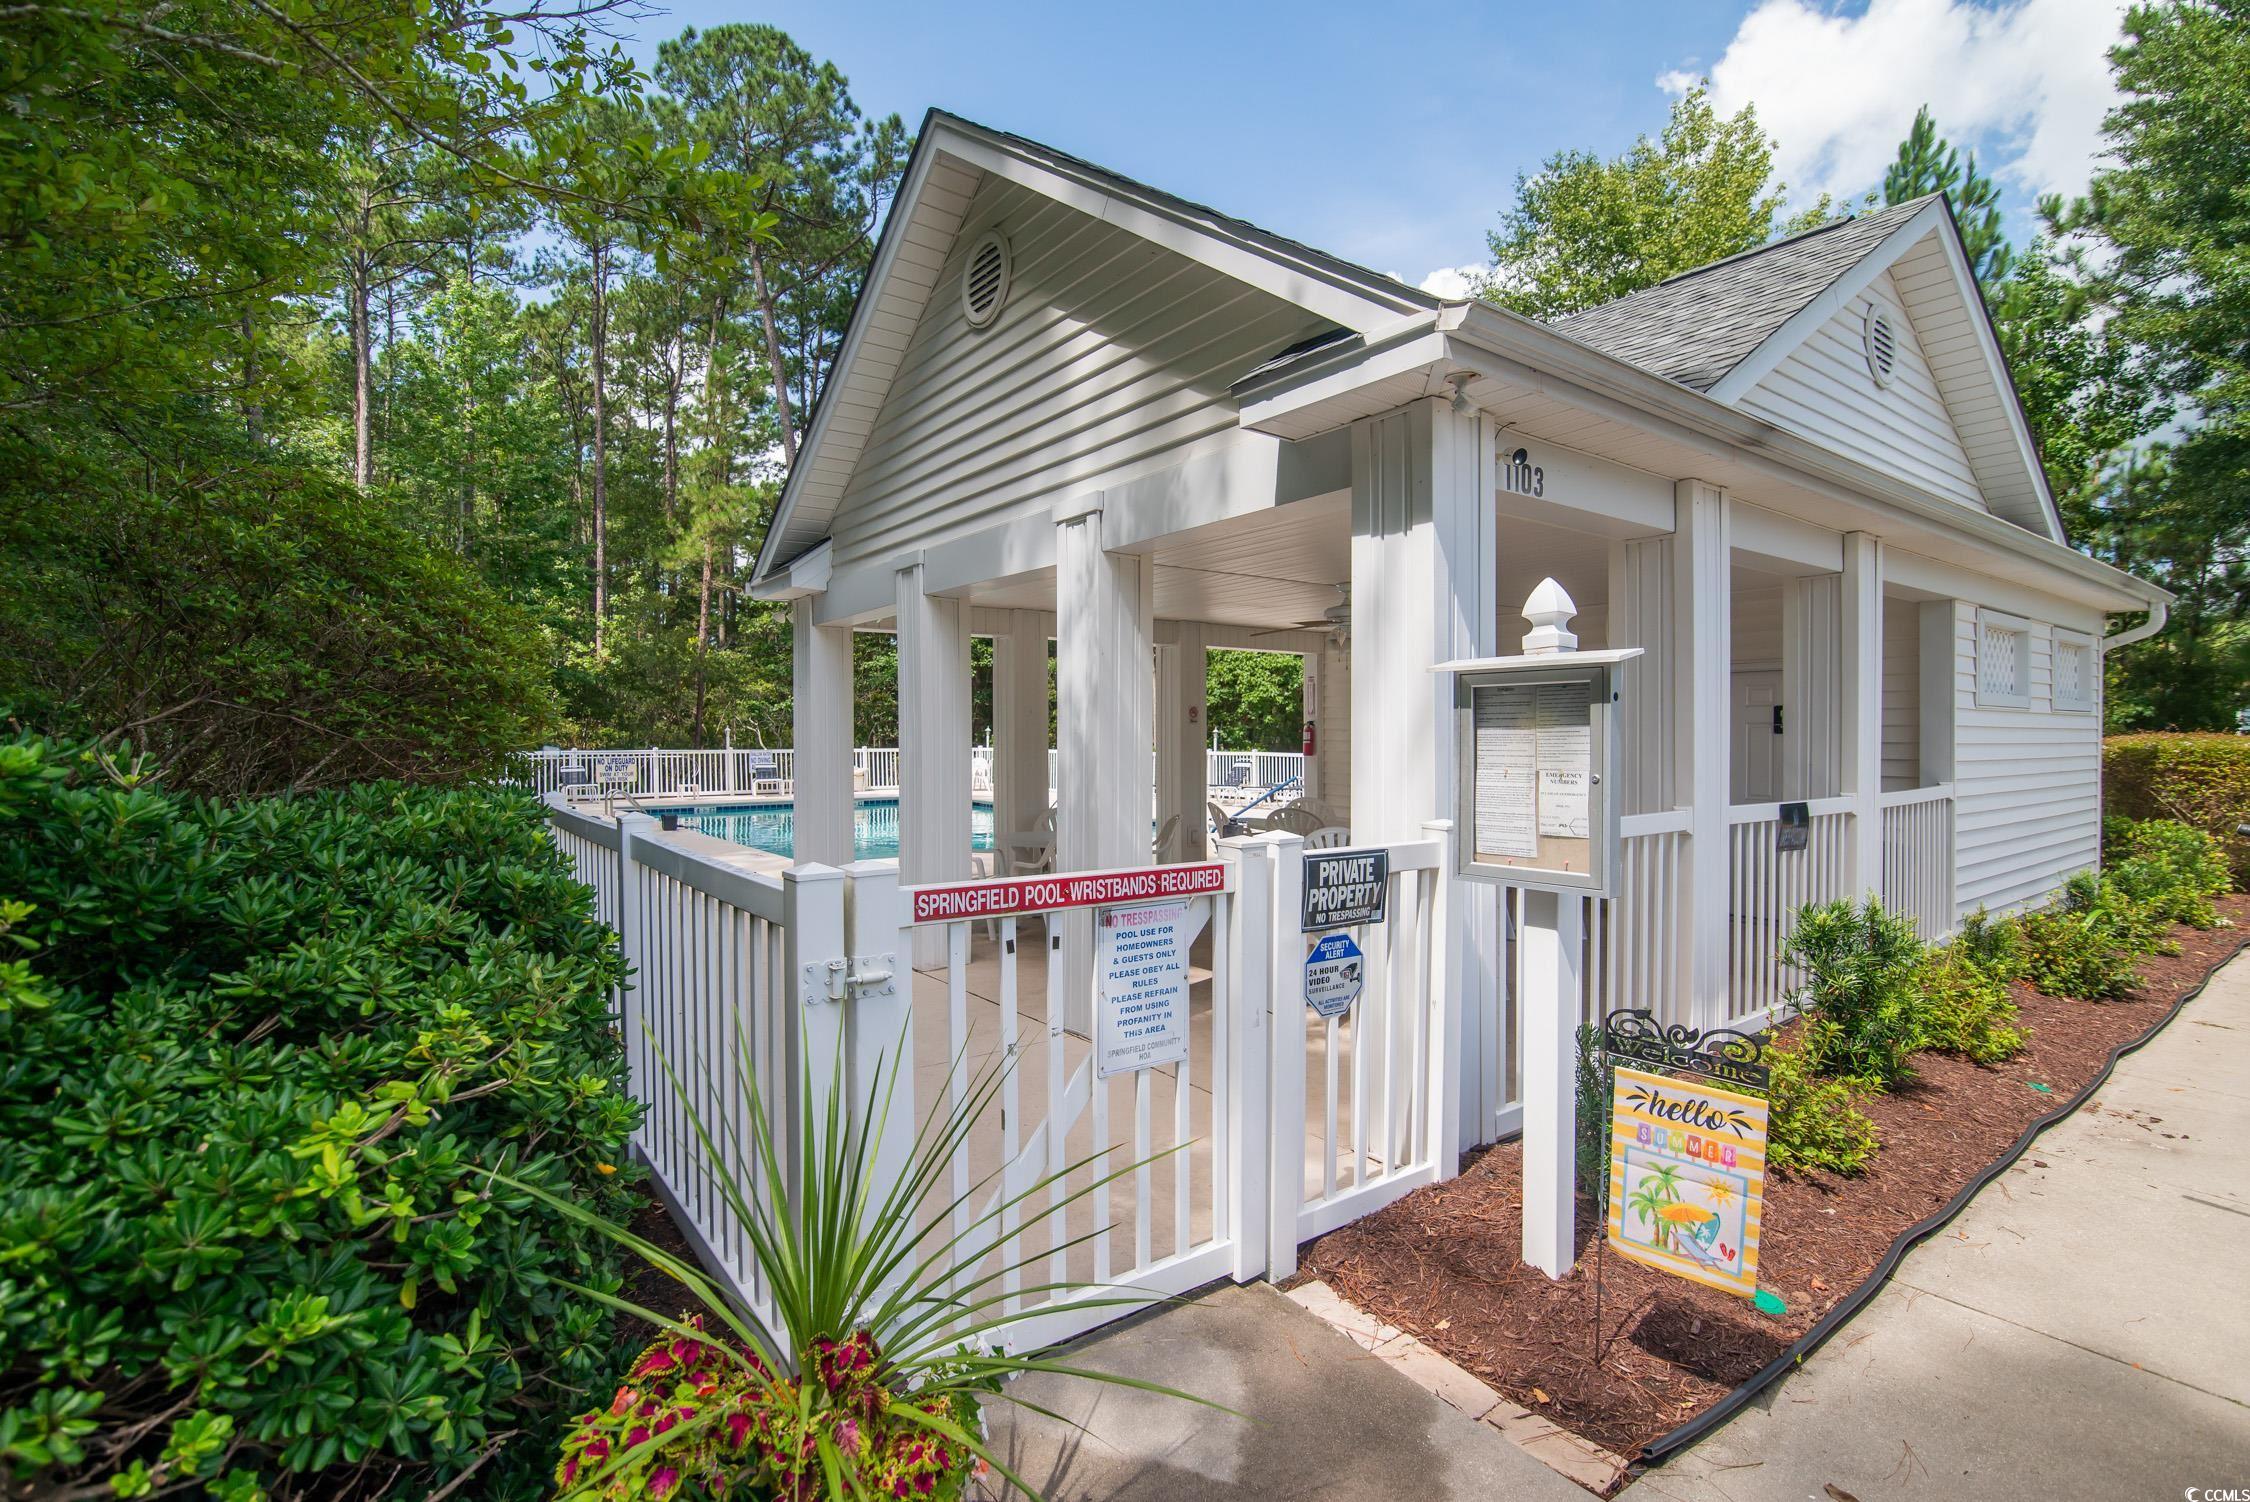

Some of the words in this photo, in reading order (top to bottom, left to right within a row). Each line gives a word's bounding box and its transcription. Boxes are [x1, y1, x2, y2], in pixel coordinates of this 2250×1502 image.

[1505, 463, 1543, 497] 1103
[1320, 858, 1374, 886] PRIVATE
[917, 888, 1020, 917] SPRINGFIELD
[1024, 882, 1065, 905] POOL
[1069, 874, 1157, 901] WRISTBANDS
[1160, 868, 1222, 892] REQUIRED
[1308, 882, 1381, 912] PROPERTY
[1105, 914, 1119, 929] NO
[1315, 912, 1326, 924] NO
[1328, 906, 1371, 922] TRESPASSING
[1116, 931, 1138, 940] POOL
[1140, 929, 1156, 937] USE
[1158, 926, 1174, 935] FOR
[1116, 938, 1174, 953] HOMEOWNERS
[1320, 939, 1350, 952] SECURITY
[1121, 952, 1154, 964] GUESTS
[1156, 949, 1177, 959] ONLY
[1325, 948, 1345, 960] ALERT
[1109, 969, 1140, 980] PLEASE
[1142, 964, 1164, 974] OBEY
[1166, 963, 1180, 971] ALL
[1308, 969, 1317, 978] 24
[1319, 965, 1339, 975] HOUR
[1132, 978, 1158, 989] RULES
[1308, 976, 1330, 987] VIDEO
[1308, 982, 1345, 995] SURVEILLANCE
[1111, 993, 1142, 1004] PLEASE
[1144, 986, 1178, 999] REFRAIN
[1120, 1005, 1143, 1015] FROM
[1145, 1000, 1170, 1010] USING
[1117, 1014, 1162, 1028] PROFANITY
[1164, 1011, 1172, 1019] IN
[1123, 1029, 1143, 1038] THIS
[1145, 1024, 1166, 1034] AREA
[1108, 1044, 1146, 1058] SPRINGFIELD
[1147, 1036, 1181, 1050] COMMUNITY
[1138, 1052, 1151, 1061] HOA
[1616, 1040, 1763, 1084] Welcome
[1648, 1089, 1727, 1131] hello
[1640, 1127, 1734, 1164] SUMMER
